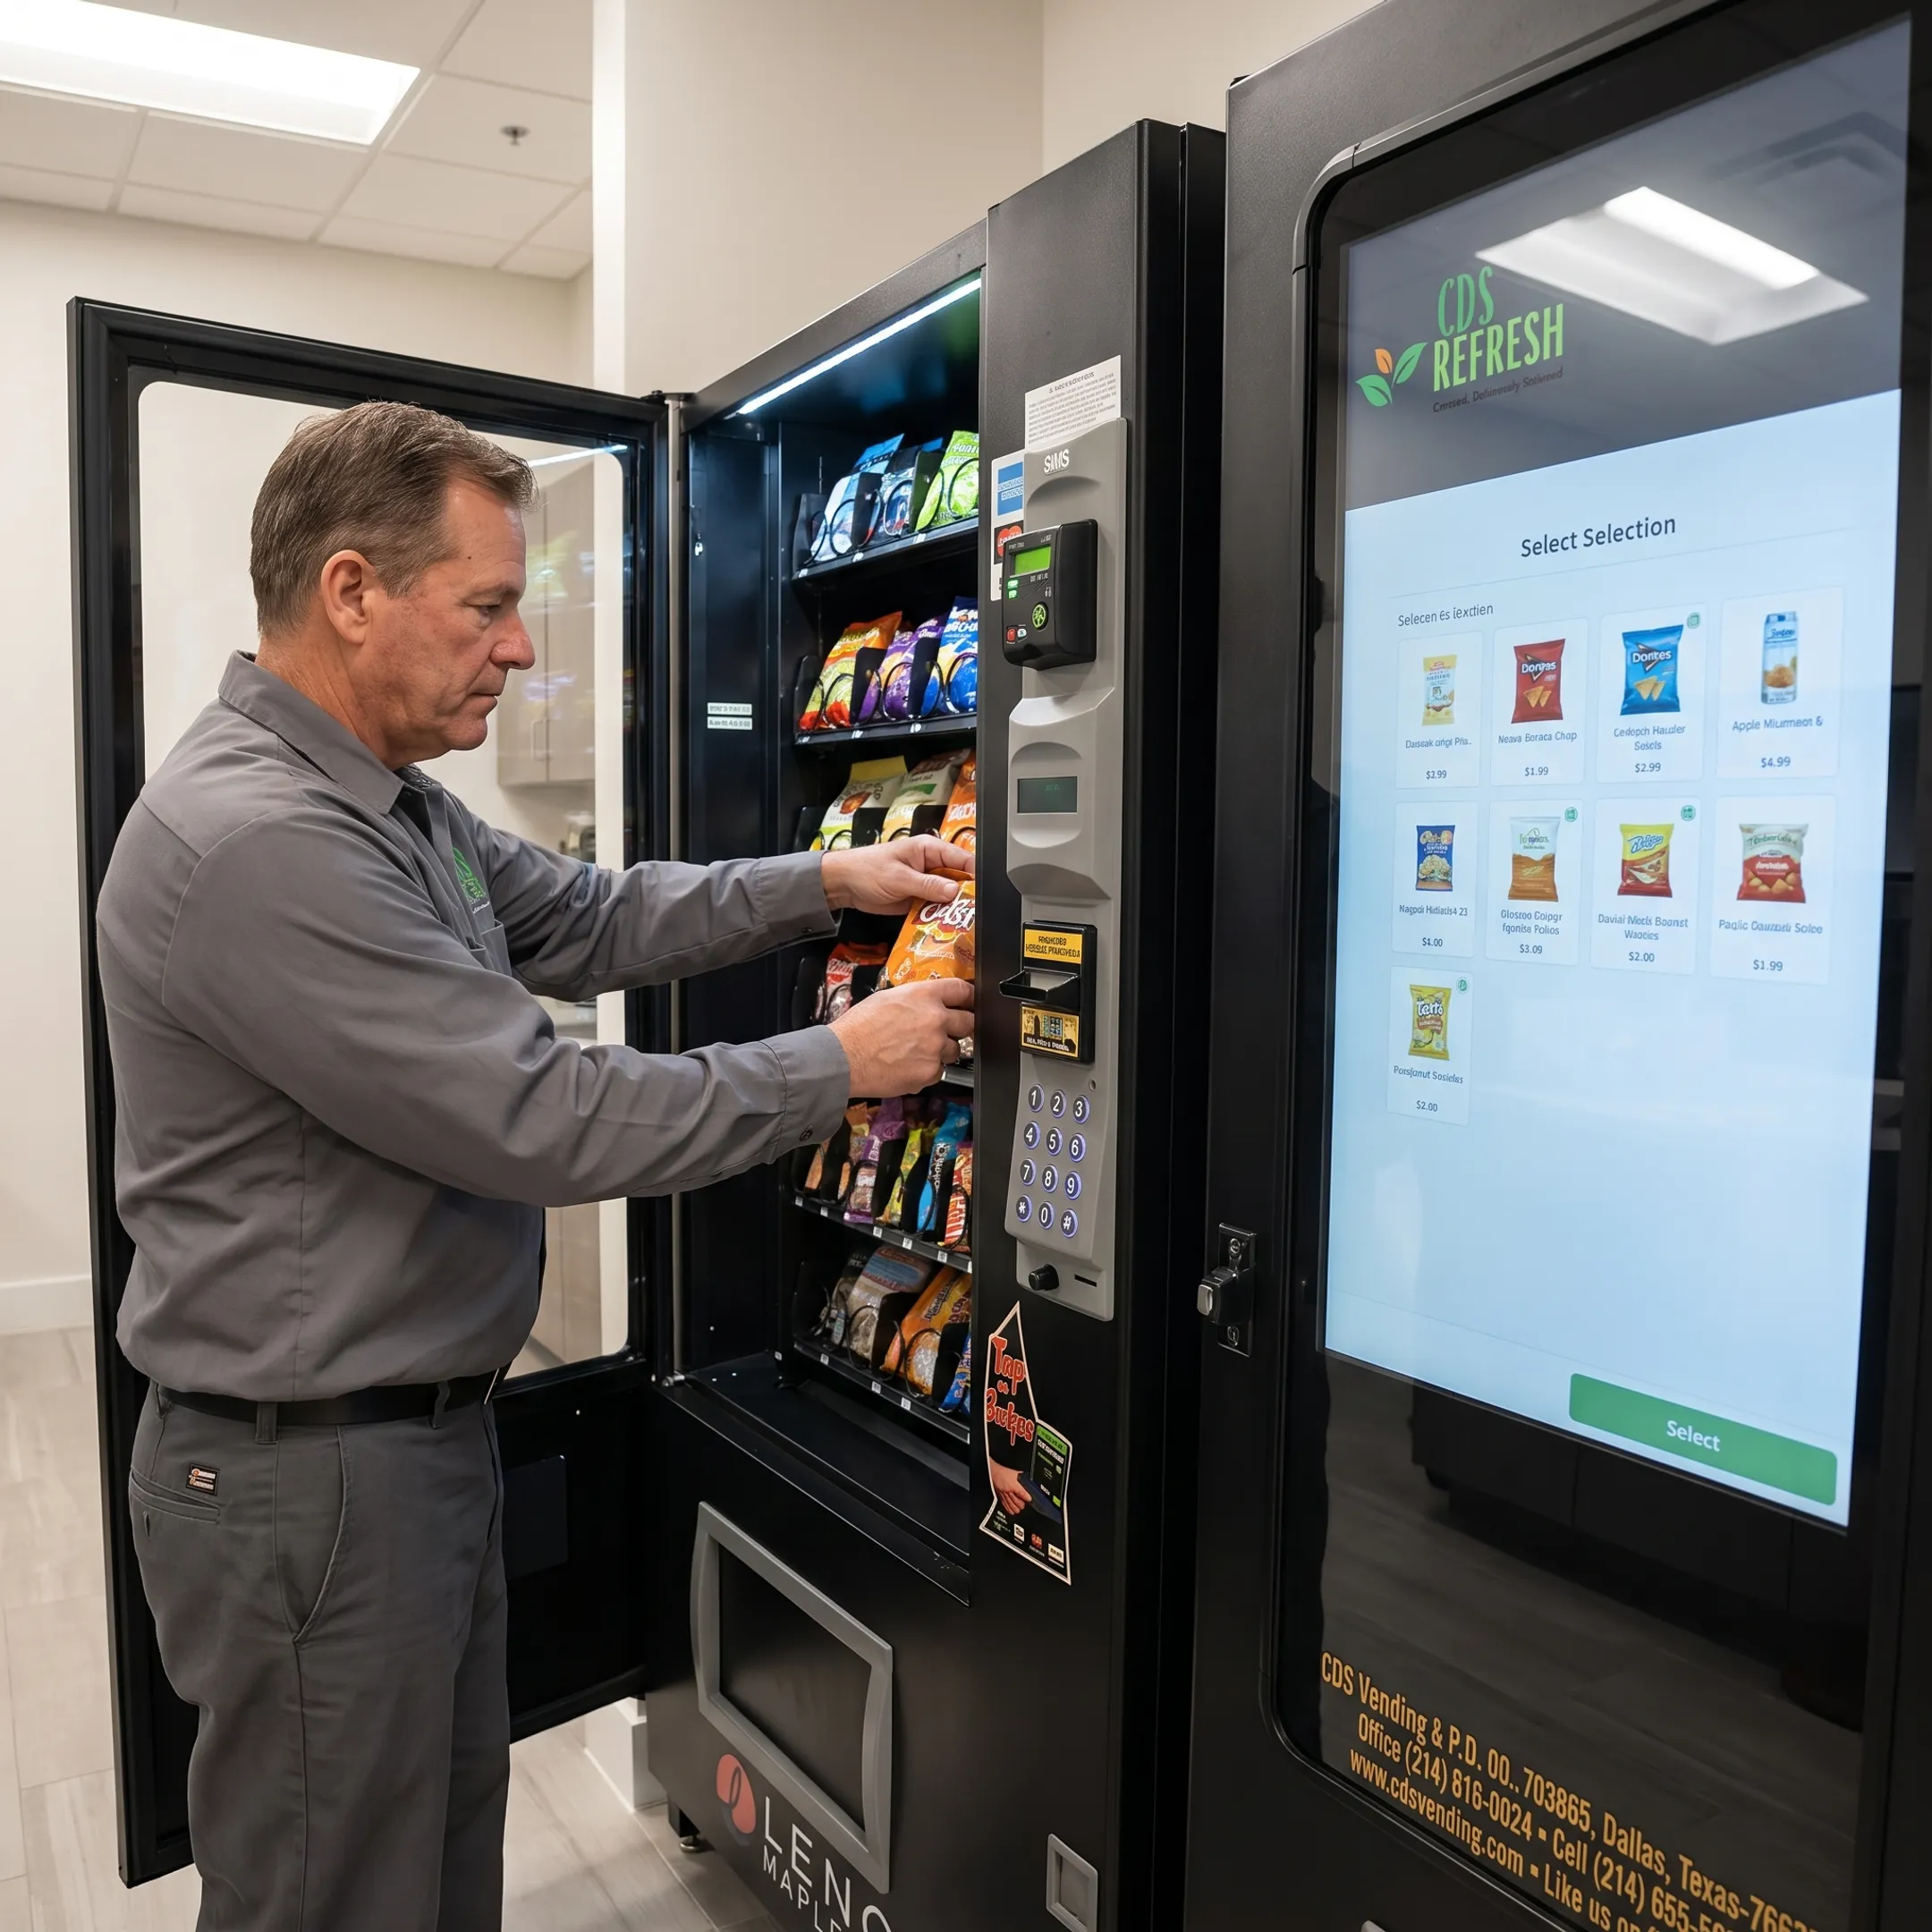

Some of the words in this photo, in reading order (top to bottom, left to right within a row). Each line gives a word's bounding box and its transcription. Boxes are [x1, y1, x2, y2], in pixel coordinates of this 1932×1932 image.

[1437, 266, 1495, 337] CDS
[1433, 302, 1564, 393] REFRESH
[1521, 530, 1578, 558] Select
[1582, 516, 1676, 547] Selection
[1732, 719, 1761, 733] Apple
[1524, 767, 1549, 777] $1.99
[1634, 762, 1662, 774] $2.99
[1760, 756, 1792, 769] $4.99
[1519, 944, 1544, 955] $3.09
[1628, 951, 1656, 963] $2.00
[1752, 959, 1784, 972] $1.99
[1030, 1089, 1038, 1106] 1
[1052, 1095, 1062, 1113] 2
[1075, 1100, 1083, 1118] 3
[1416, 1099, 1439, 1113] $2.00
[1025, 1127, 1034, 1143] 4
[1048, 1132, 1057, 1150] 5
[1071, 1139, 1080, 1157] 6
[1023, 1164, 1030, 1182] 7
[1044, 1170, 1053, 1187] 8
[1066, 1176, 1075, 1194] 9
[1040, 1207, 1049, 1224] 0
[990, 1335, 1026, 1396] Tap
[1665, 1419, 1722, 1453] Select
[1320, 1651, 1355, 1696] CDS
[1358, 1671, 1428, 1747] Vending
[1430, 1716, 1444, 1750] &
[1448, 1724, 1482, 1772] P.D.
[1522, 1766, 1597, 1842] 703865,
[1602, 1811, 1671, 1885] Dallas,
[1358, 1712, 1402, 1763] Office
[1404, 1740, 1448, 1795] (214)
[1452, 1767, 1533, 1842] 816-0024
[1552, 1827, 1589, 1876] Cell
[1593, 1850, 1646, 1915] (214)
[1350, 1749, 1524, 1877] www.cdsvending.com
[1544, 1863, 1583, 1913] Like
[1589, 1896, 1612, 1932] us
